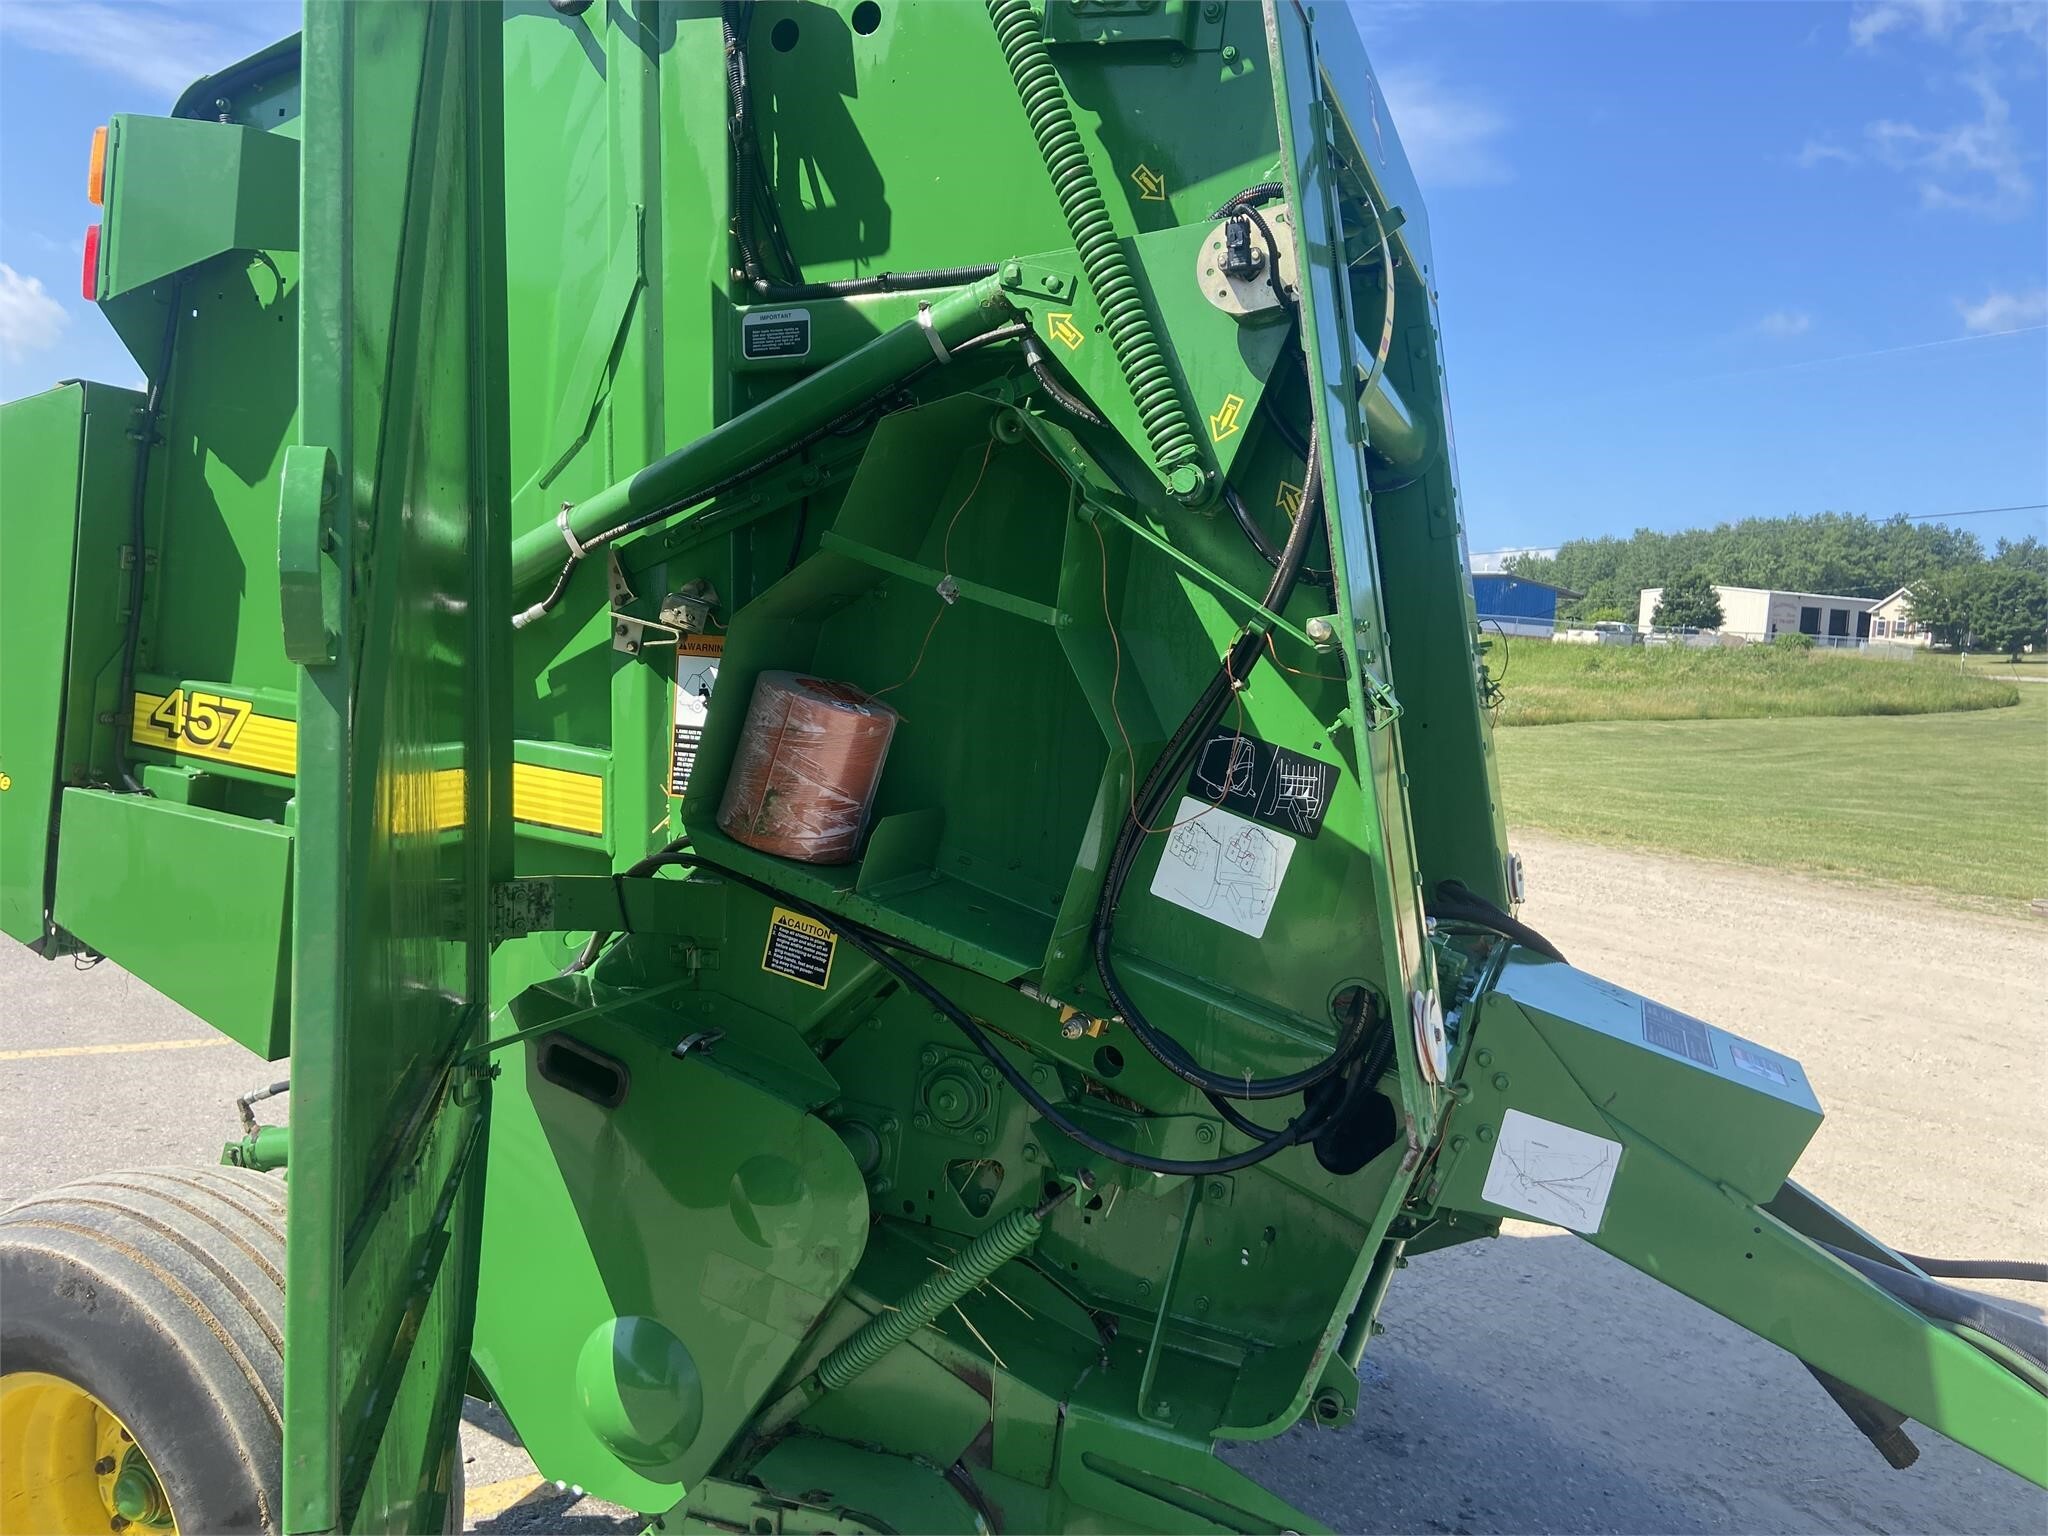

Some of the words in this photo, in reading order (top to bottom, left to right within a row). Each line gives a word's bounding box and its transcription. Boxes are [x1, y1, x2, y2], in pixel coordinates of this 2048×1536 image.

[687, 642, 723, 652] WARNIN
[150, 688, 253, 750] 457
[788, 919, 831, 939] CAUTION
